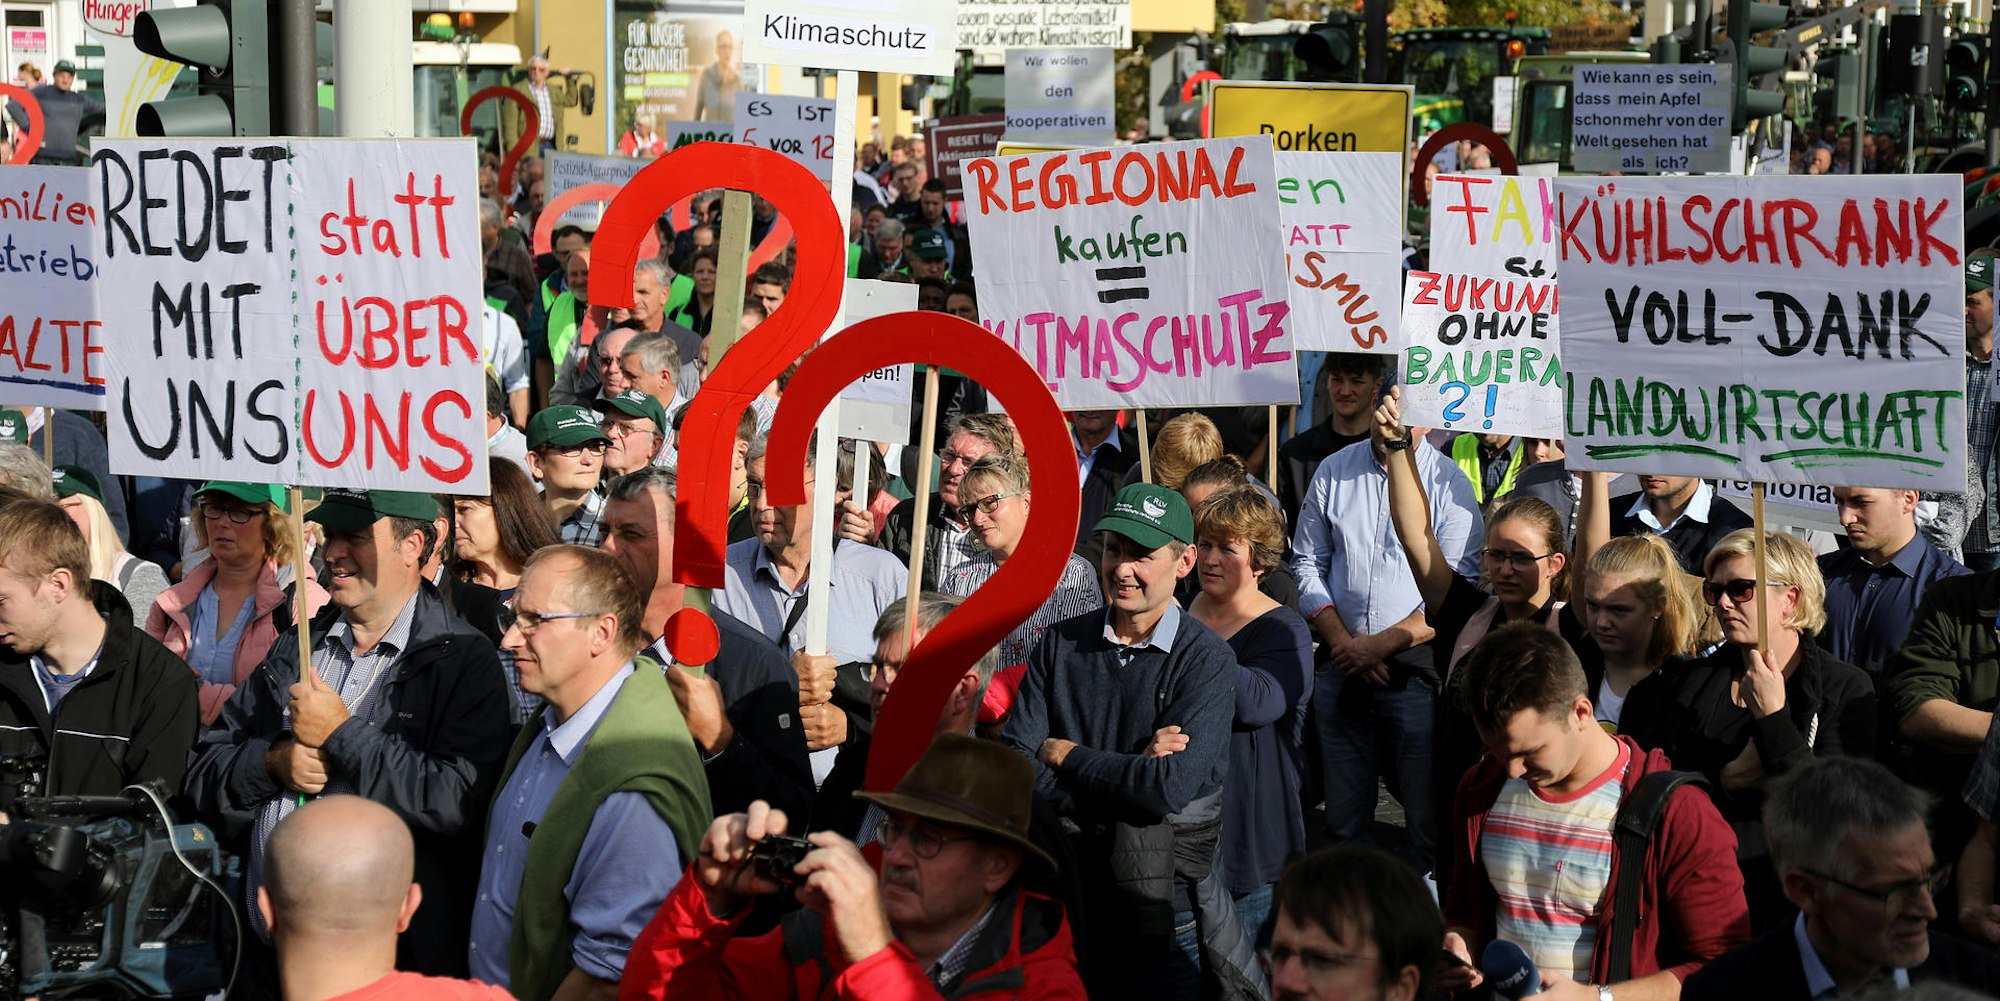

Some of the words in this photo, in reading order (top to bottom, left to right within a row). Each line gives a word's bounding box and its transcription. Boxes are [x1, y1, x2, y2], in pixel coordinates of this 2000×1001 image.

[627, 19, 647, 47] FÜR
[650, 23, 686, 47] UNSERE
[764, 14, 927, 50] Klimaschutz
[624, 46, 689, 73] GESUNDHEIT
[1024, 56, 1044, 67] Wir
[1050, 55, 1088, 66] wollen
[1045, 85, 1073, 97] den
[1582, 70, 1611, 84] Wie
[1614, 71, 1650, 84] kann
[1656, 73, 1674, 84] es
[1679, 71, 1717, 86] sein,
[747, 101, 773, 117] ES
[797, 105, 833, 122] IST
[1575, 92, 1611, 105] dass
[1618, 92, 1656, 105] mein
[1660, 92, 1701, 107] Apfel
[1006, 114, 1106, 130] kooperativen
[1575, 113, 1621, 127] schon
[1623, 113, 1662, 127] mehr
[1667, 115, 1695, 127] von
[1698, 113, 1725, 127] der
[769, 138, 804, 154] VOR
[811, 134, 834, 160] 12
[947, 134, 980, 147] RESET
[1259, 124, 1357, 152] Borken
[1575, 134, 1609, 147] Welt
[1612, 135, 1678, 150] gesehen
[1683, 135, 1708, 148] hat
[1622, 155, 1645, 168] als
[1655, 155, 1689, 169] ich?
[966, 146, 1256, 215] REGIONAL
[92, 145, 295, 263] REDET
[319, 171, 456, 259] statt
[1054, 214, 1188, 264] kaufen
[1282, 224, 1352, 246] ATT
[1558, 182, 1961, 268] KÜHLSCHRANK
[0, 234, 99, 281] trieb
[1408, 269, 1559, 315] ZUKUN
[150, 281, 261, 360] MIT
[315, 273, 479, 370] ÜBER
[1437, 311, 1549, 346] OHNE
[1439, 380, 1499, 430] ?!
[1566, 370, 1964, 452] LANDWIRTSCHAFT
[122, 376, 289, 465] UNS
[301, 388, 474, 484] UNS
[1721, 479, 1837, 504] reiona
